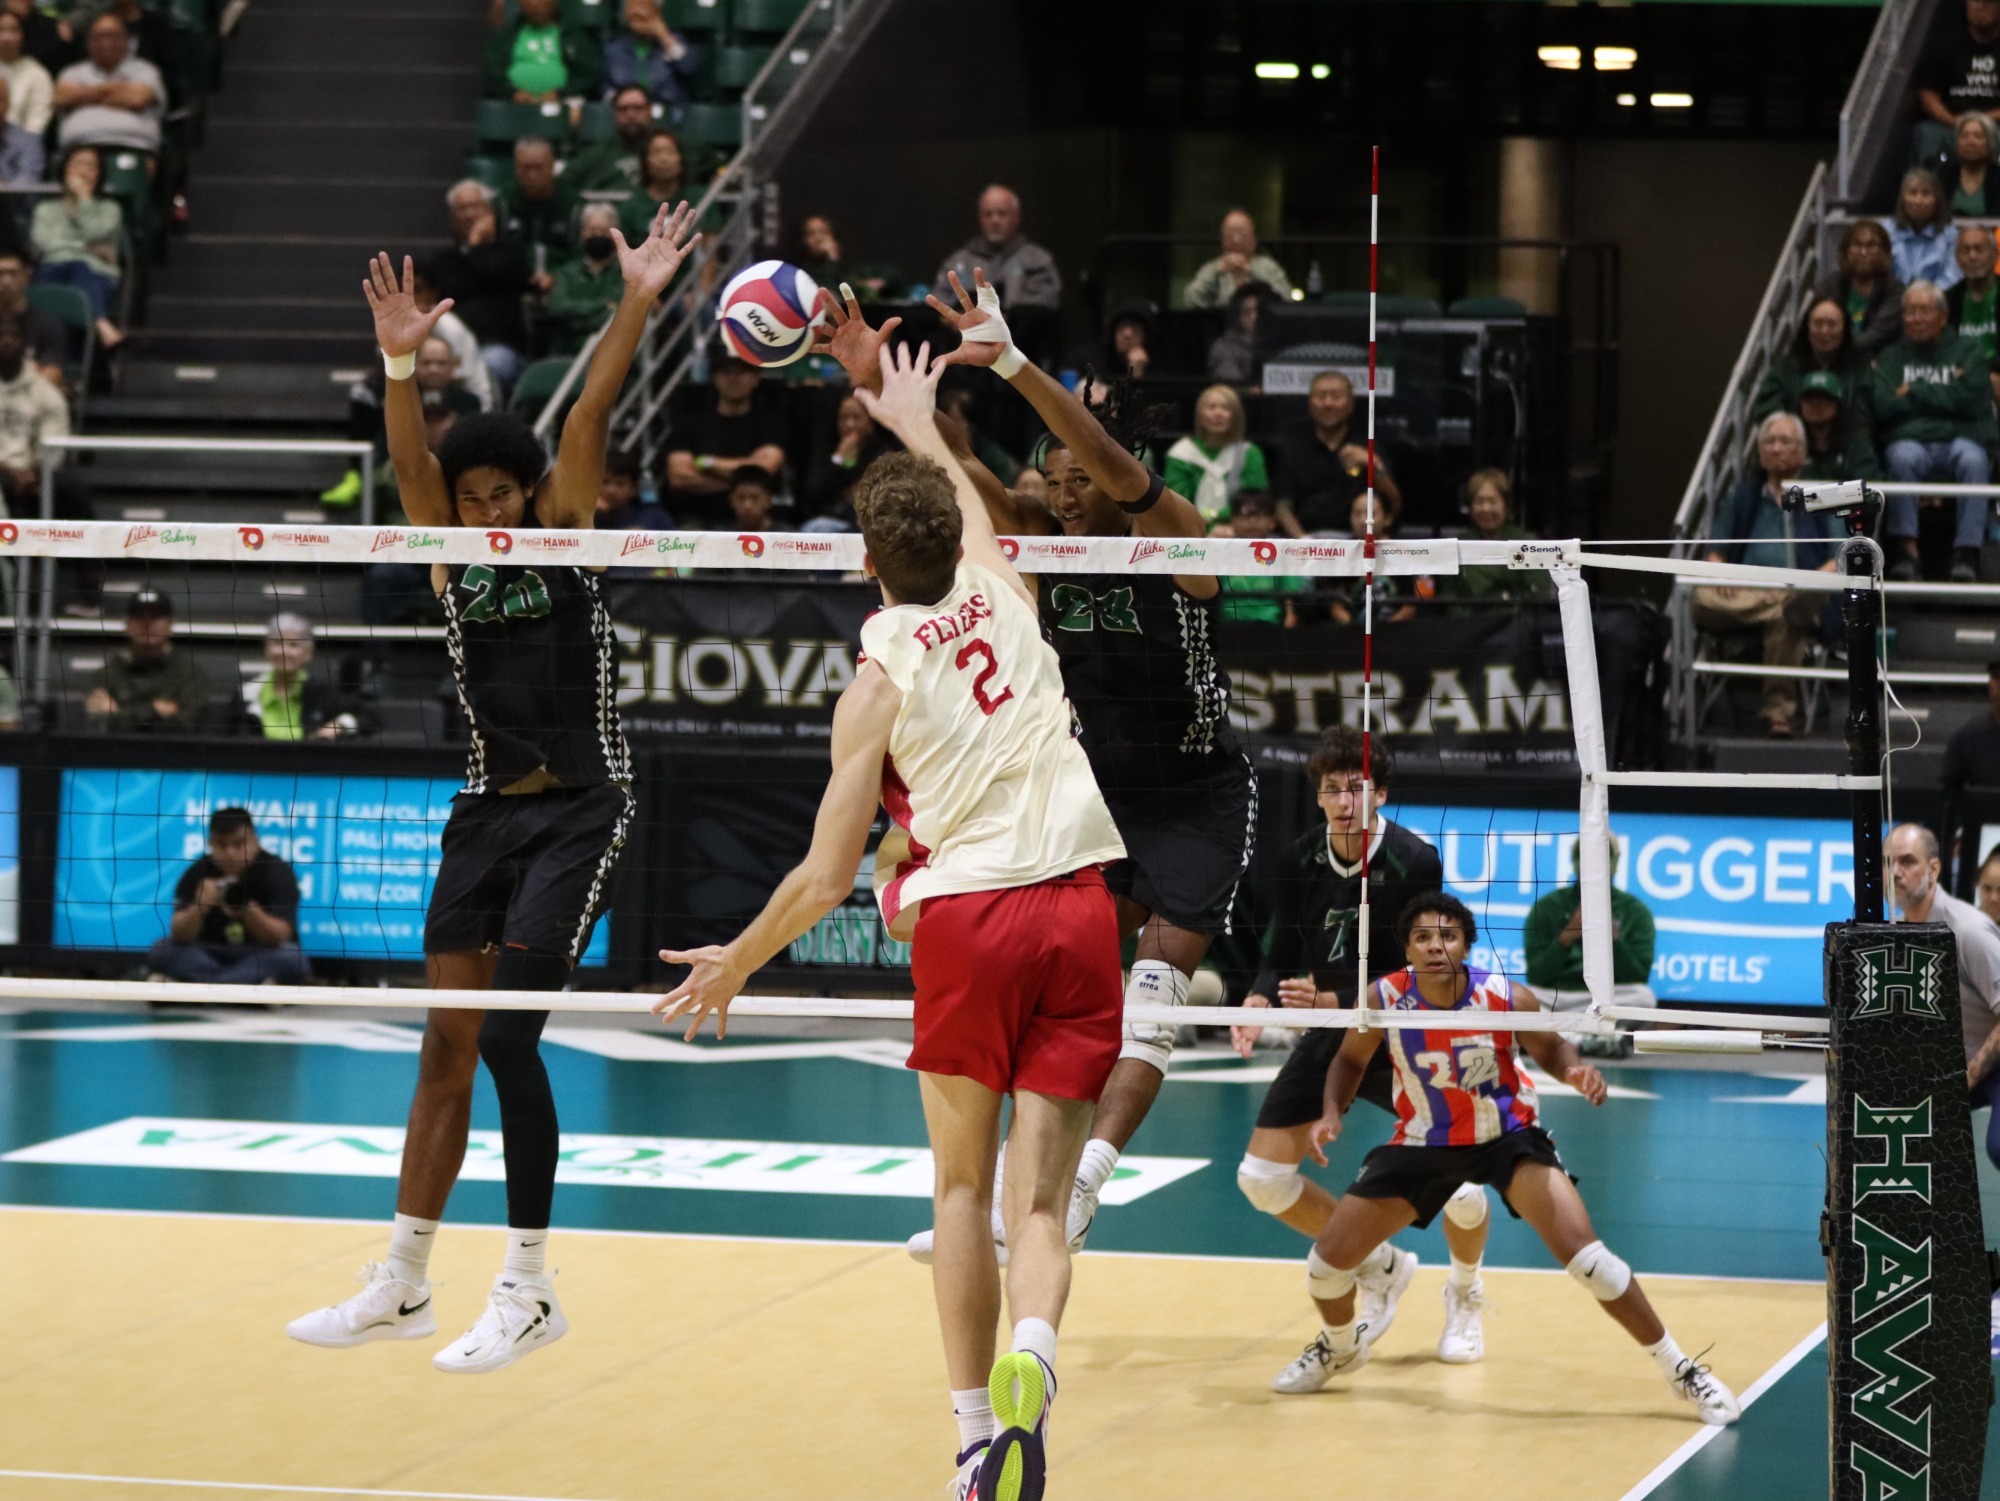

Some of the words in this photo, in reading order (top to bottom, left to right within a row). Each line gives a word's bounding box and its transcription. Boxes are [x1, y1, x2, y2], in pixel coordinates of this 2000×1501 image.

[745, 308, 780, 343] NCAA
[50, 529, 84, 539] HAWAII
[160, 530, 197, 546] Bakery
[294, 534, 329, 544] HAWAII
[407, 533, 445, 550] Bakery
[543, 537, 579, 547] HAWAII
[657, 537, 696, 554] Bakery
[795, 541, 832, 551] HAWAII
[1051, 544, 1087, 555] HAWAII
[1167, 544, 1206, 561] Bakery
[1309, 547, 1345, 557] HAWAII
[1381, 548, 1403, 556] sports
[1404, 548, 1429, 556] imports
[1530, 545, 1561, 553] Senoh
[955, 638, 1014, 716] 2
[1324, 908, 1359, 962] 7
[1850, 943, 1948, 1021] H
